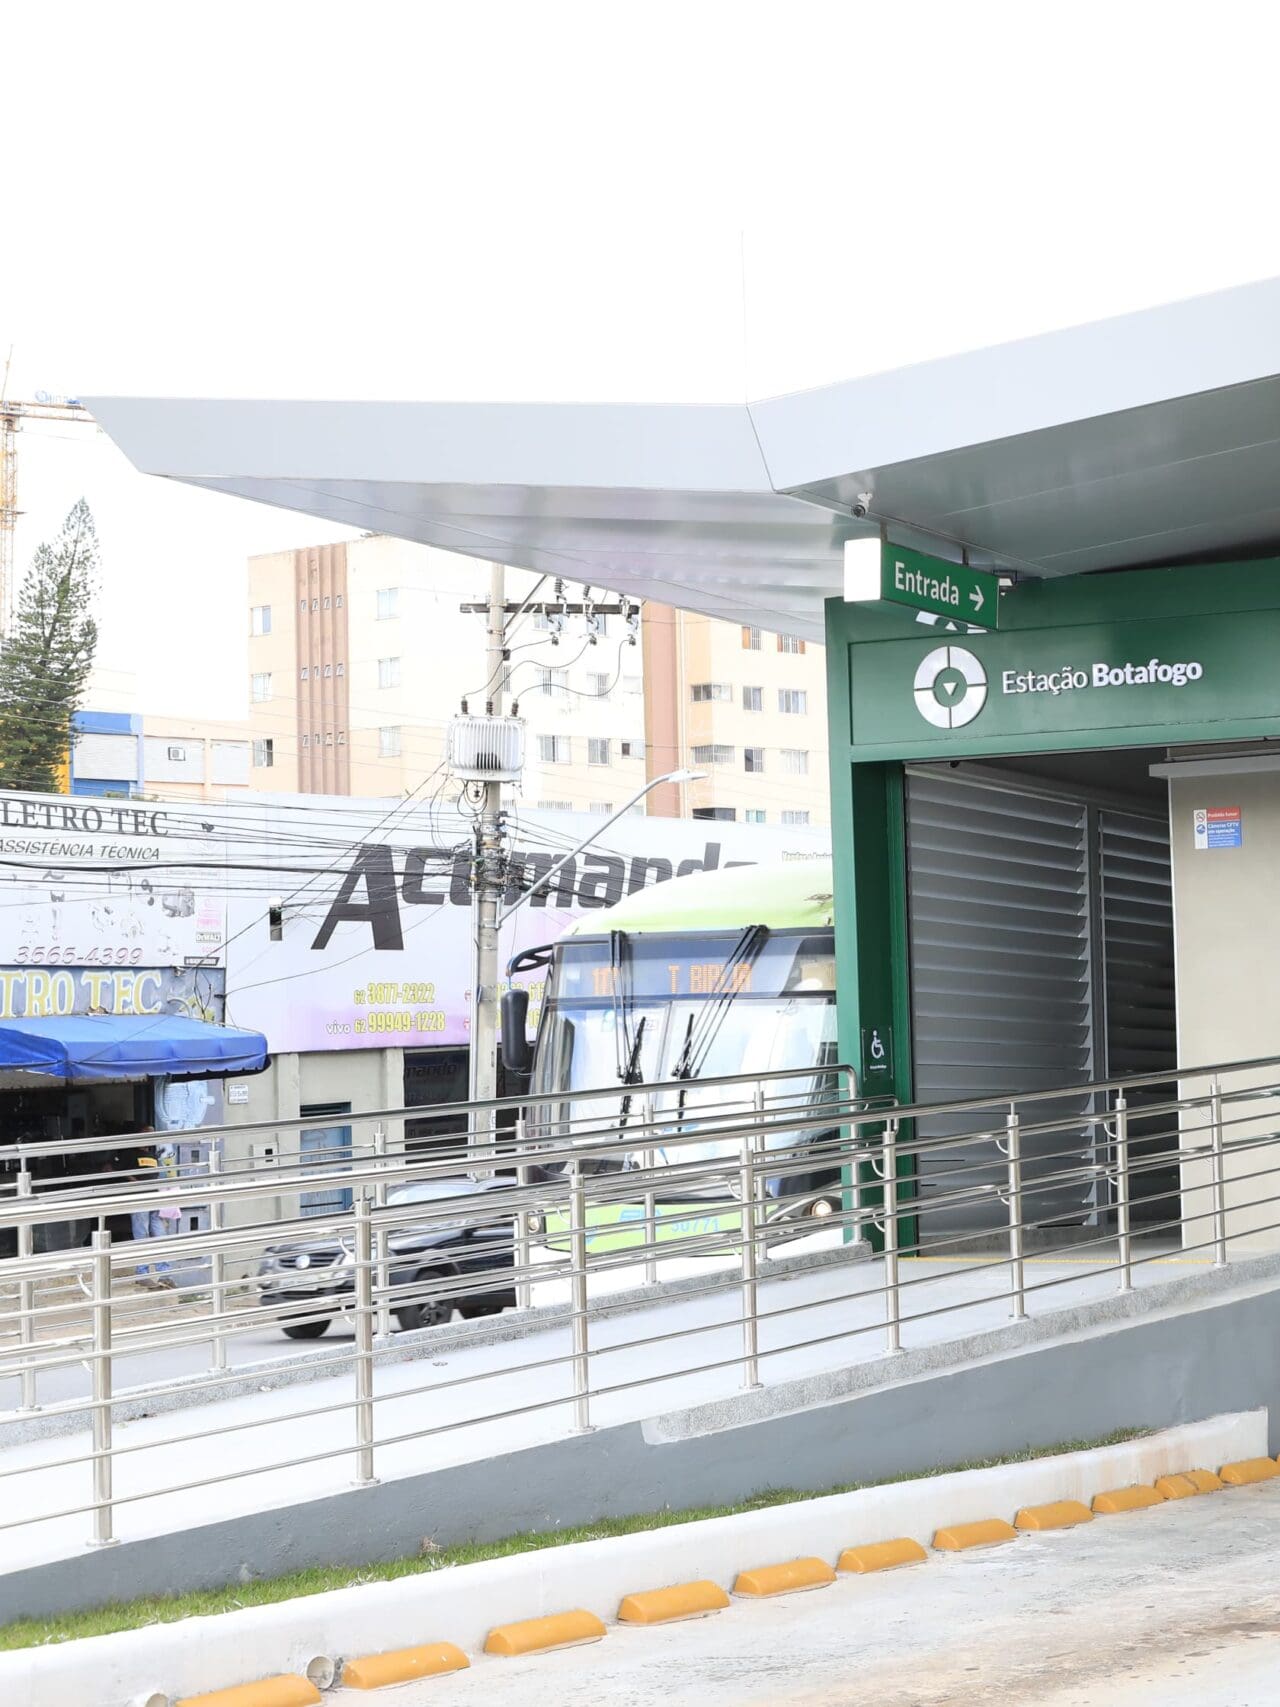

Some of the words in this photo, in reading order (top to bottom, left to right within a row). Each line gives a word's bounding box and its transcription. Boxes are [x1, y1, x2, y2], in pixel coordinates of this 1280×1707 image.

[895, 560, 959, 606] Entrada
[1002, 665, 1089, 695] Estação
[1092, 658, 1204, 687] Botafogo
[111, 807, 169, 836] TEC
[100, 842, 160, 860] TÉCNICA
[80, 970, 162, 1014] TEC
[354, 989, 367, 1005] 62
[367, 982, 435, 1004] 3877-2322
[326, 1021, 351, 1034] vivo
[354, 1018, 367, 1033] 62
[367, 1011, 446, 1033] 99949-1228
